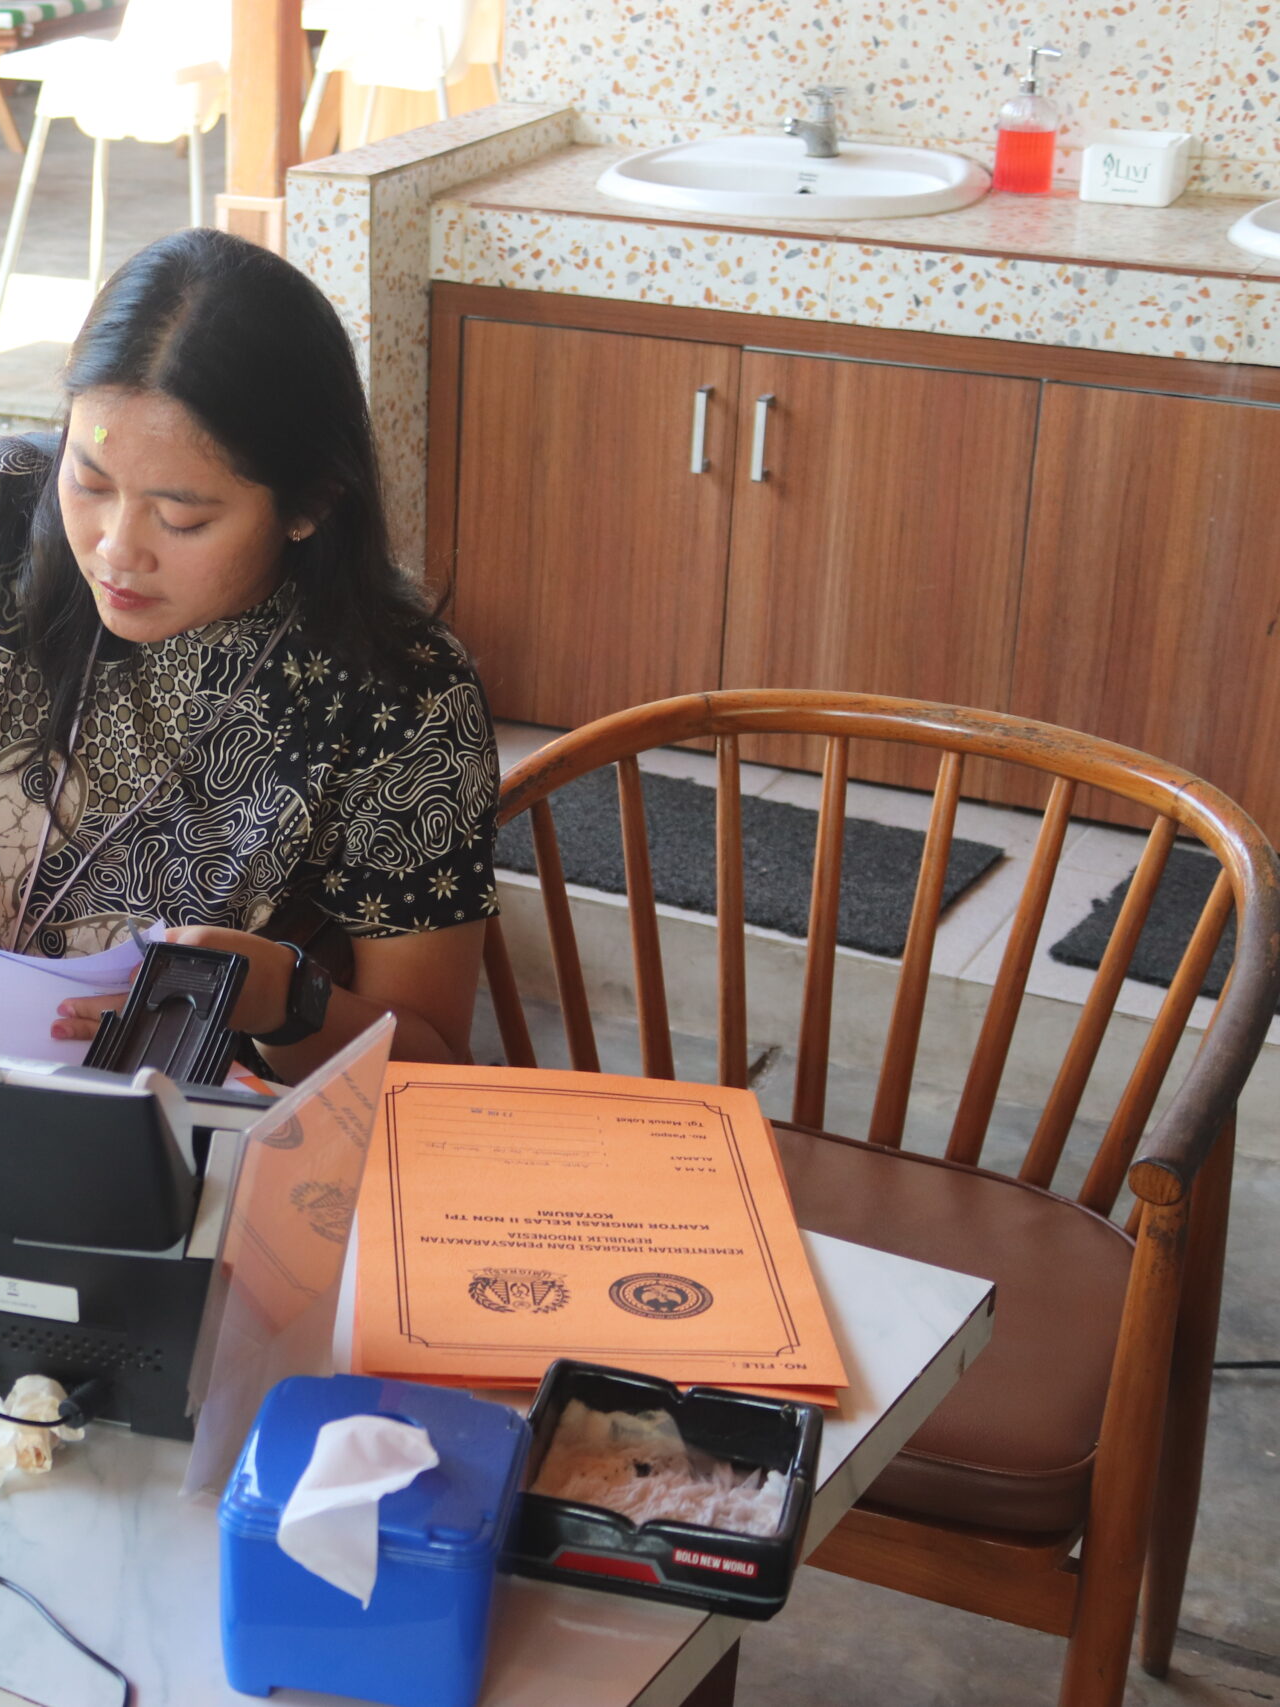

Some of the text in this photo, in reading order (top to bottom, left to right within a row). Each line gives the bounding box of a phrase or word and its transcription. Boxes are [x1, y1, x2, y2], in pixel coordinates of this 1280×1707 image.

[445, 1213, 468, 1221] TPI
[537, 1209, 614, 1219] KOTABUMI
[472, 1215, 505, 1223] NON
[524, 1218, 572, 1226] KELAS
[576, 1220, 643, 1229] IMIGRASI
[648, 1223, 710, 1231] KANTOR
[507, 1232, 653, 1245] REPUBLIK INDONESIA
[420, 1236, 744, 1255] KEMENTERIAN IMIGRASI DAN PEMASYARAKATAN
[675, 1549, 755, 1576] BOLD NEW WORLD
